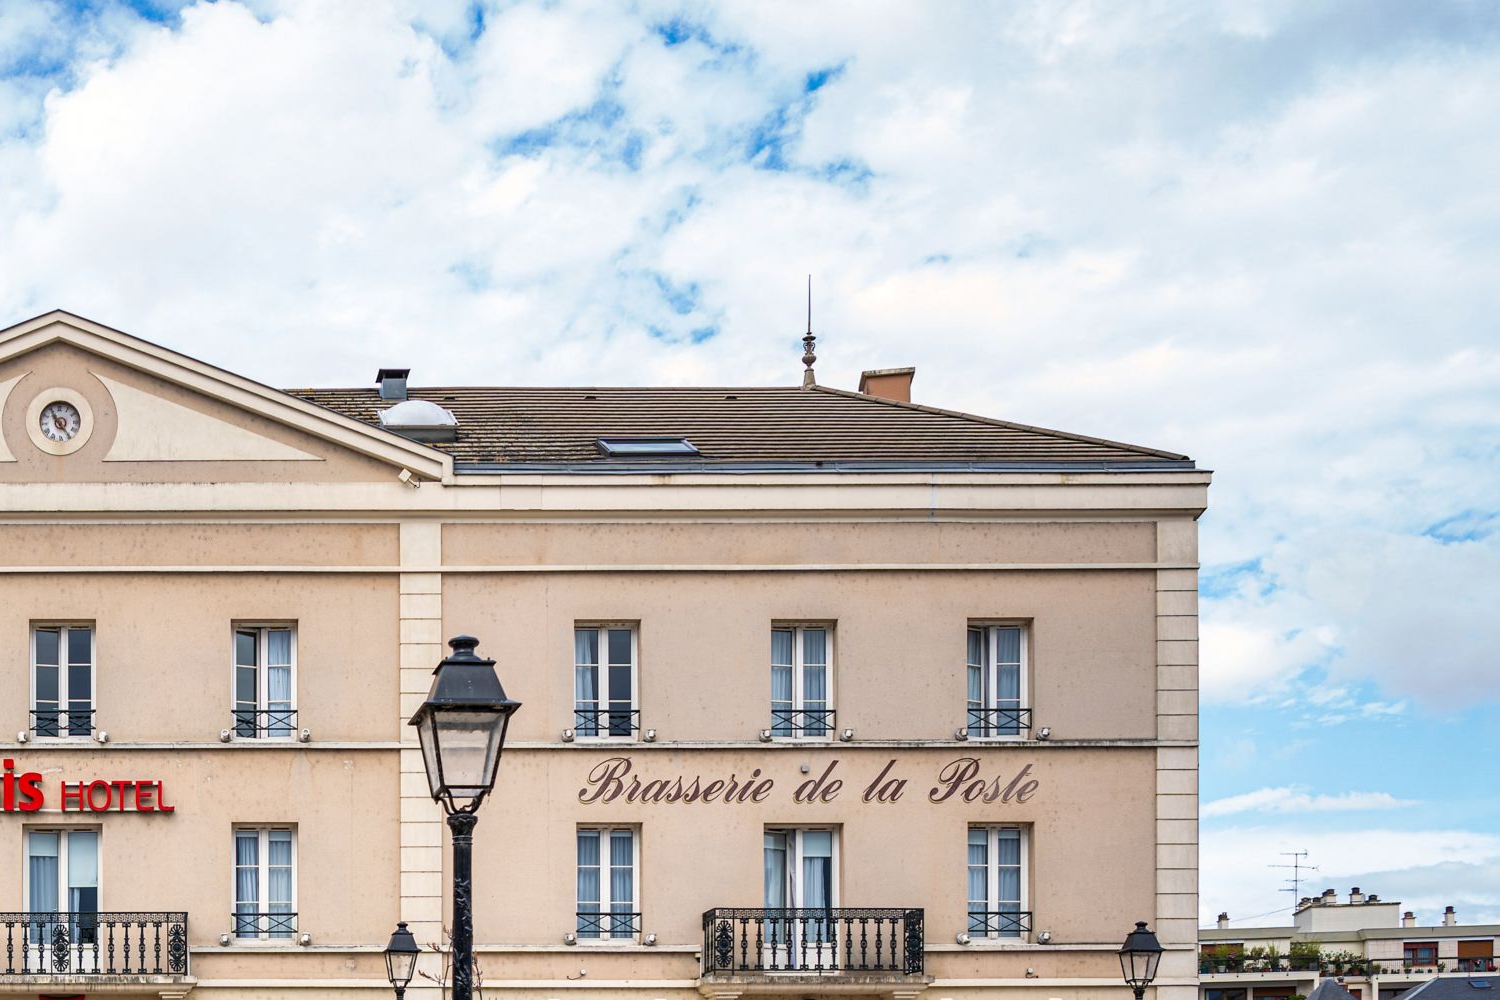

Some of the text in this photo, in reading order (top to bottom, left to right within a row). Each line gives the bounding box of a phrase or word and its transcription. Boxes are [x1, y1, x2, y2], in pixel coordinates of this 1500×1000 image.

[61, 779, 175, 813] HOTEL
[577, 756, 1040, 805] Brasserie de la Poste
